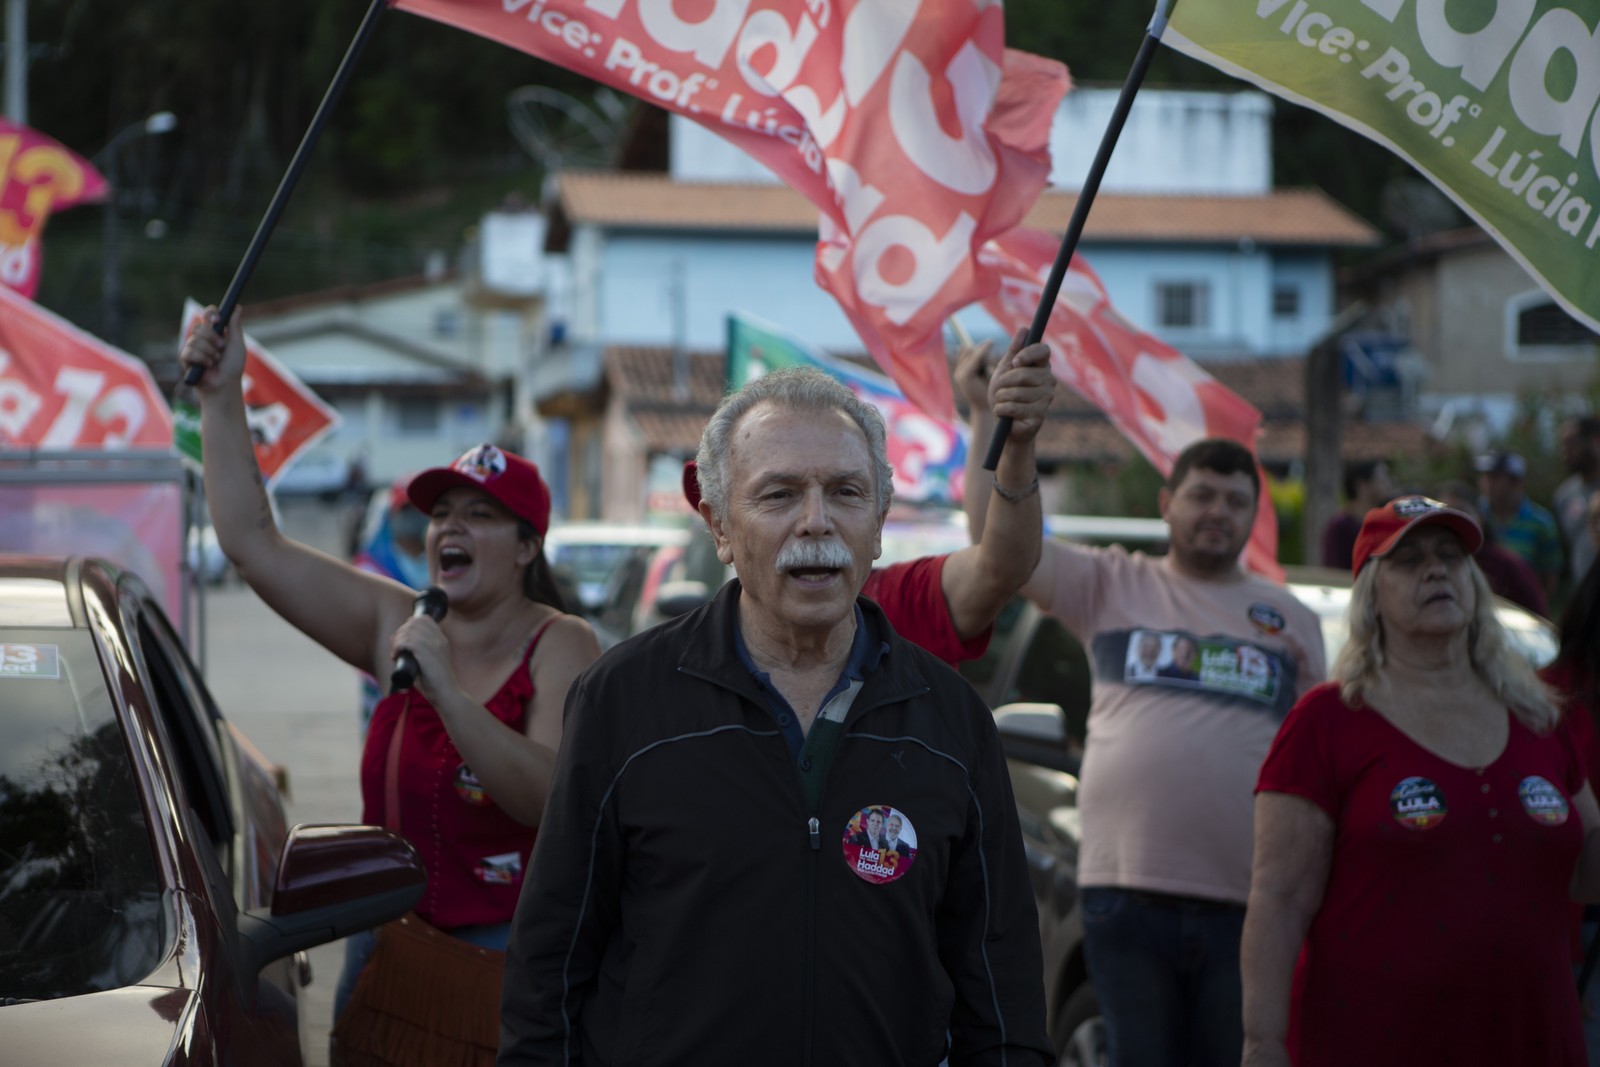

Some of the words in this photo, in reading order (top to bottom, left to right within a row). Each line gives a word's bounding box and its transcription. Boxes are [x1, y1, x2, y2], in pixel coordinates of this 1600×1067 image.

[1471, 126, 1592, 236] Lúcia
[1397, 796, 1440, 813] LULA
[857, 859, 895, 876] Haddad
[859, 847, 880, 860] Lula
[878, 848, 900, 870] 13
